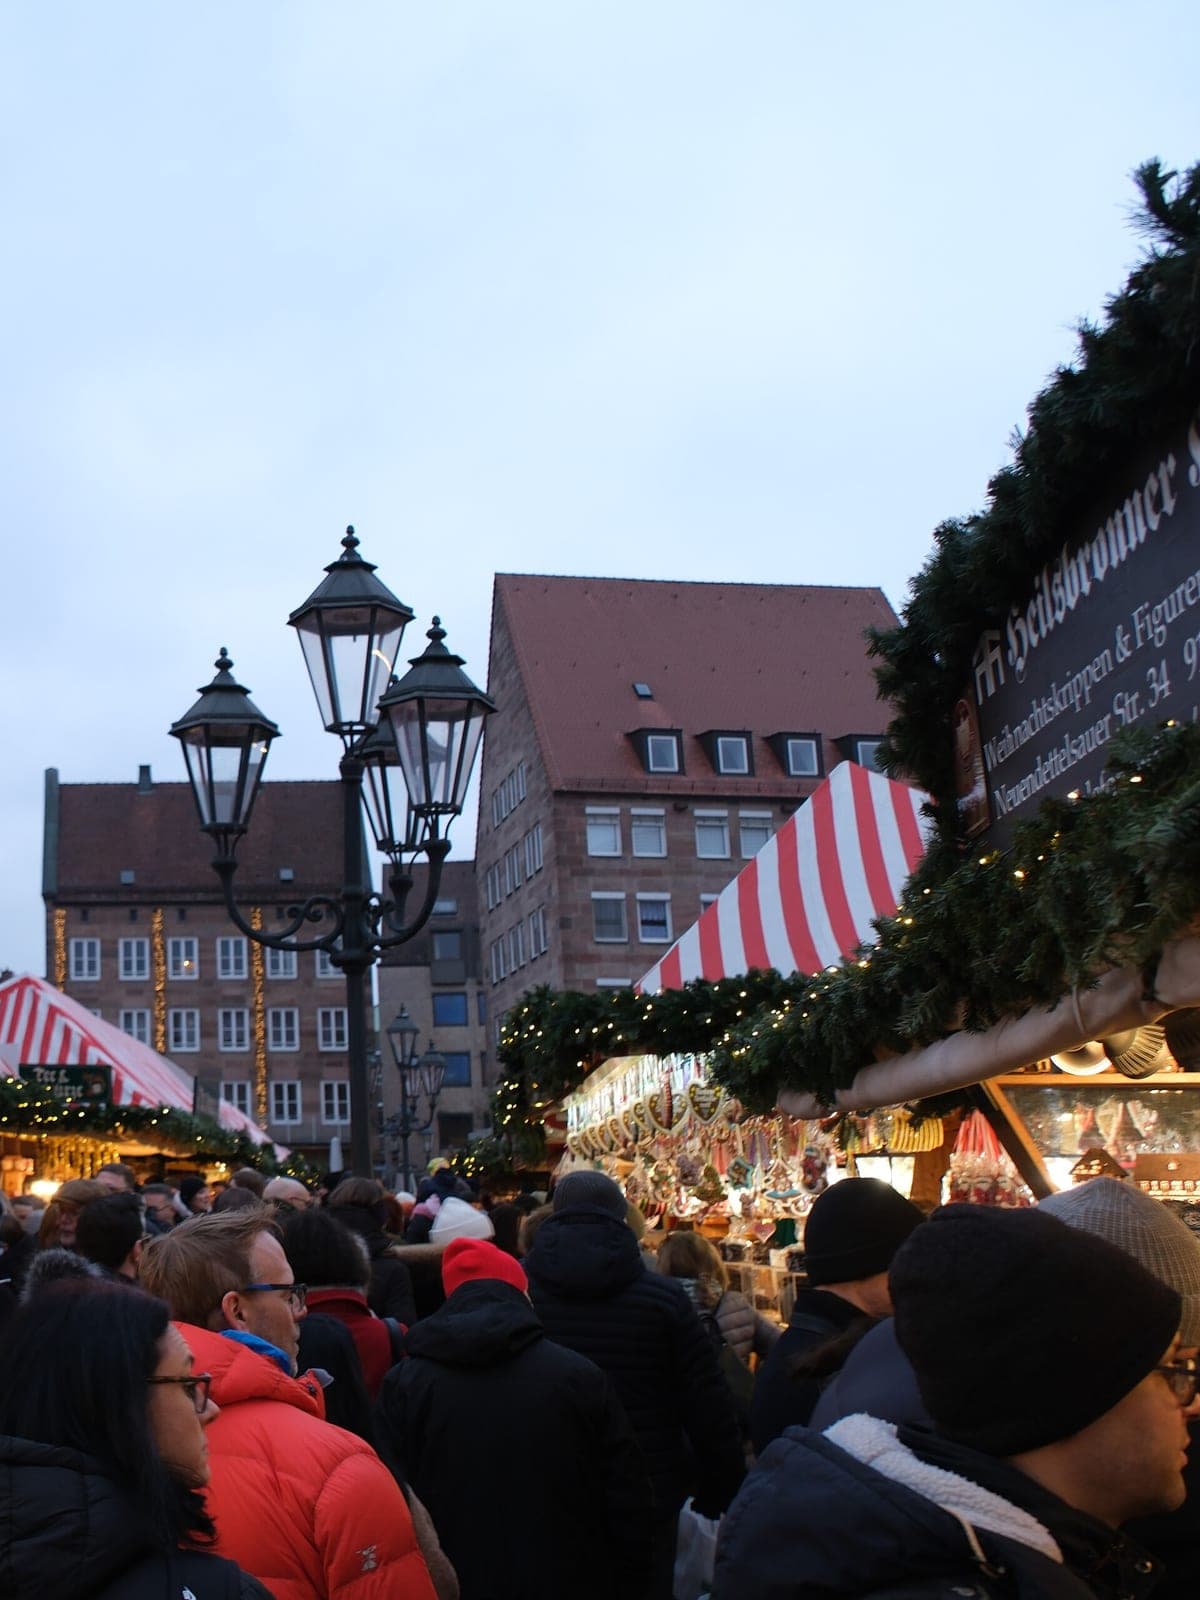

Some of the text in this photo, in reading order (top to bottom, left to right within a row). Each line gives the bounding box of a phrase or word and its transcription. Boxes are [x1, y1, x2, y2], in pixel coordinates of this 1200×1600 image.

[1006, 452, 1177, 683] Heilsbronner
[983, 648, 1114, 772] Weihnachtskrippen
[1115, 624, 1133, 664] &
[993, 713, 1112, 820] Neuendettelsauer
[1112, 690, 1145, 731] Str.
[1146, 658, 1173, 708] 34
